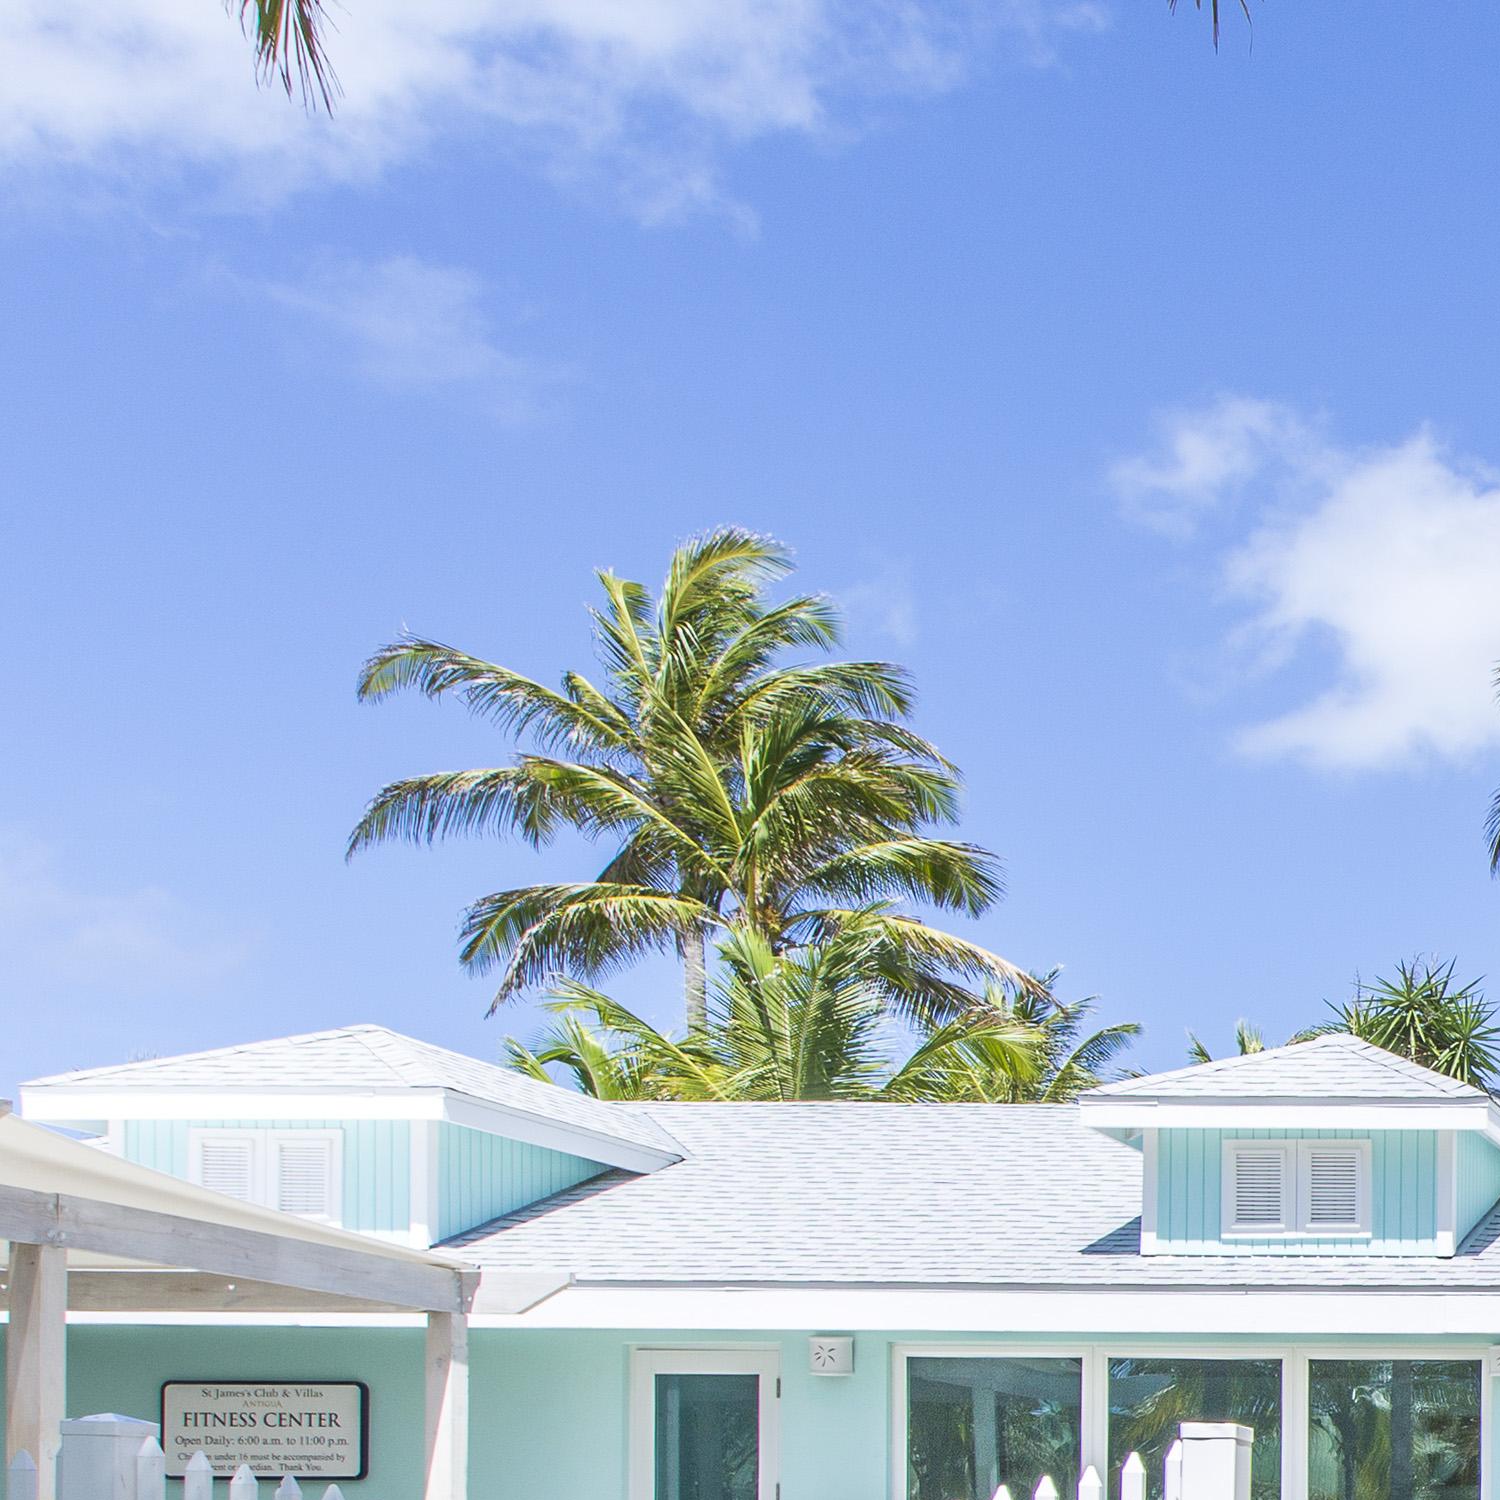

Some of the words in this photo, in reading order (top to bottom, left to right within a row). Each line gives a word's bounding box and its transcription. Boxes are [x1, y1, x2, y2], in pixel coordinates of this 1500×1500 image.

[202, 1388, 212, 1398] St
[213, 1388, 252, 1400] James's
[254, 1388, 279, 1398] Club
[282, 1389, 290, 1398] &
[295, 1388, 324, 1398] Villas
[242, 1400, 283, 1409] ANTIGUA
[183, 1411, 257, 1427] FITNESS
[263, 1411, 341, 1428] CENTER
[175, 1435, 202, 1447] Open
[204, 1435, 236, 1447] Daily:
[238, 1435, 260, 1445] 6:00
[262, 1437, 284, 1445] a.m.
[286, 1437, 297, 1446] to
[300, 1435, 326, 1446] 11:00
[328, 1438, 350, 1447] p.m.
[215, 1452, 236, 1460] under
[250, 1453, 270, 1461] must
[283, 1453, 334, 1462] accompanied
[336, 1453, 346, 1463] by
[280, 1463, 303, 1471] Thank
